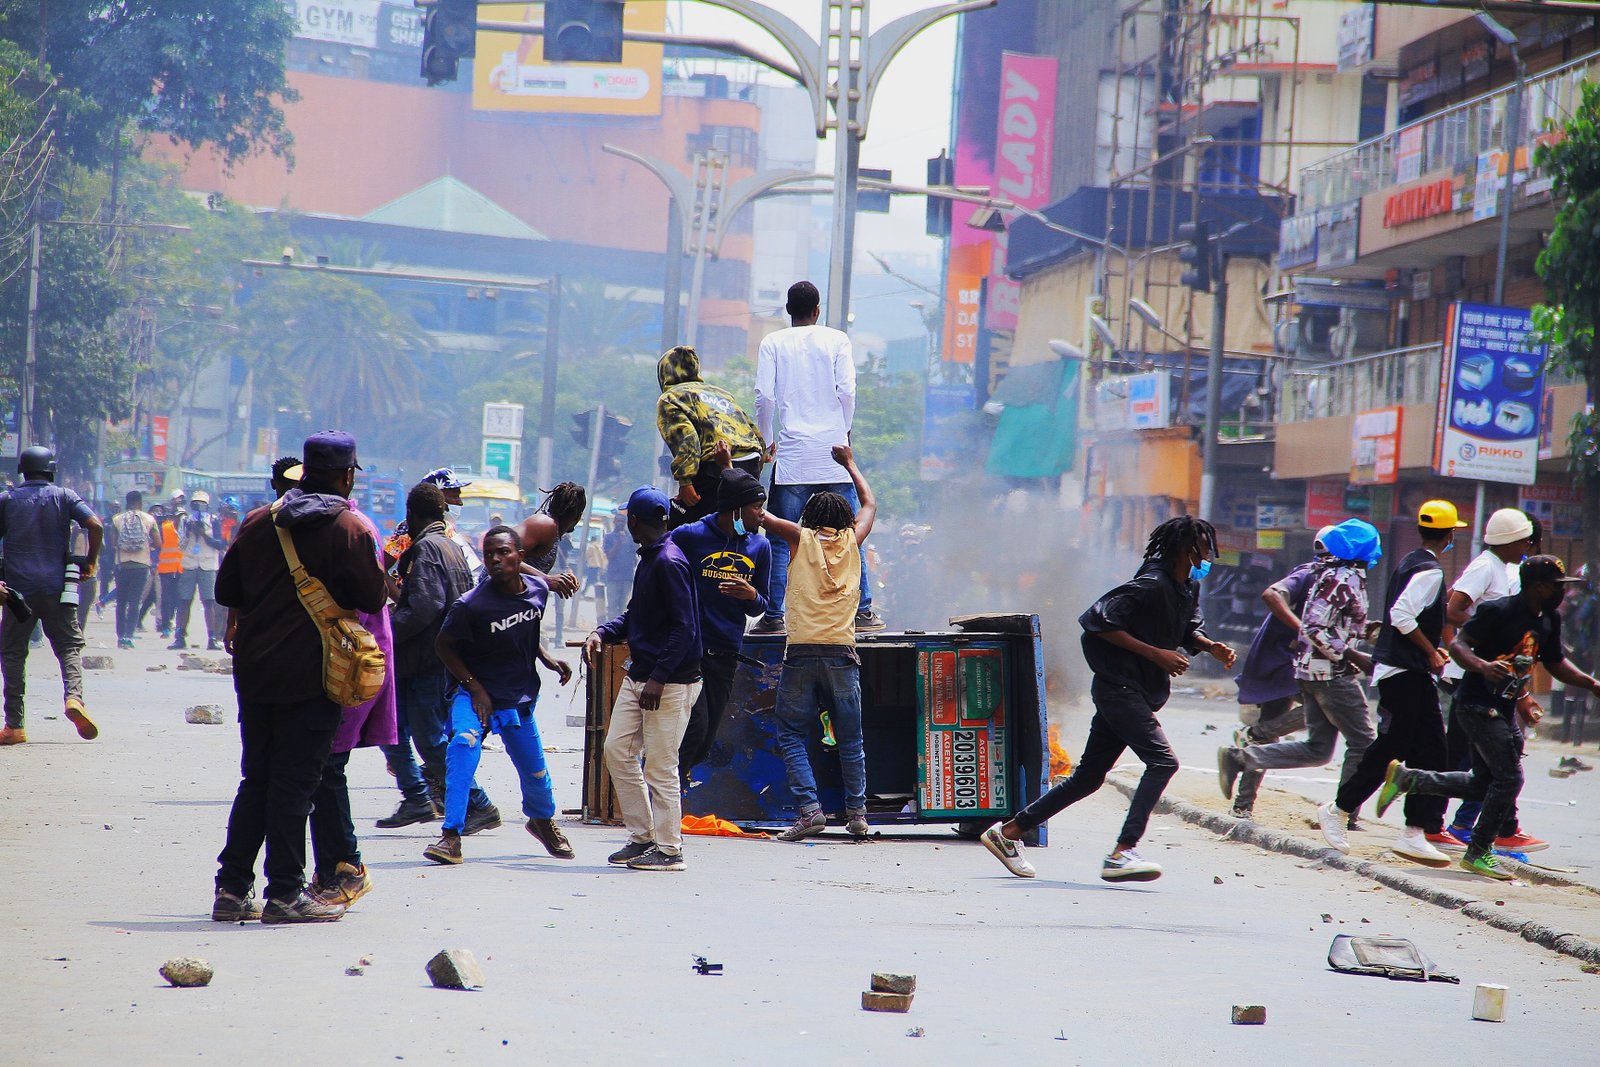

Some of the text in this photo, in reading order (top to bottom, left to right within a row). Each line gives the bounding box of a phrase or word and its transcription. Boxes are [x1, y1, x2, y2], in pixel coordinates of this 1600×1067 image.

[306, 5, 353, 33] GYM
[1460, 326, 1475, 338] FOR
[1462, 311, 1484, 326] YOUR
[1484, 313, 1501, 328] ONE
[1501, 315, 1523, 330] STOP
[1478, 446, 1523, 460] RIKKO
[702, 568, 753, 582] HUDSONILLE
[490, 608, 541, 633] NOKIA
[935, 658, 944, 719] LINES AVAILABLE
[944, 733, 952, 772] AGENT
[979, 738, 987, 778] AGENT
[954, 731, 976, 809] 2039603
